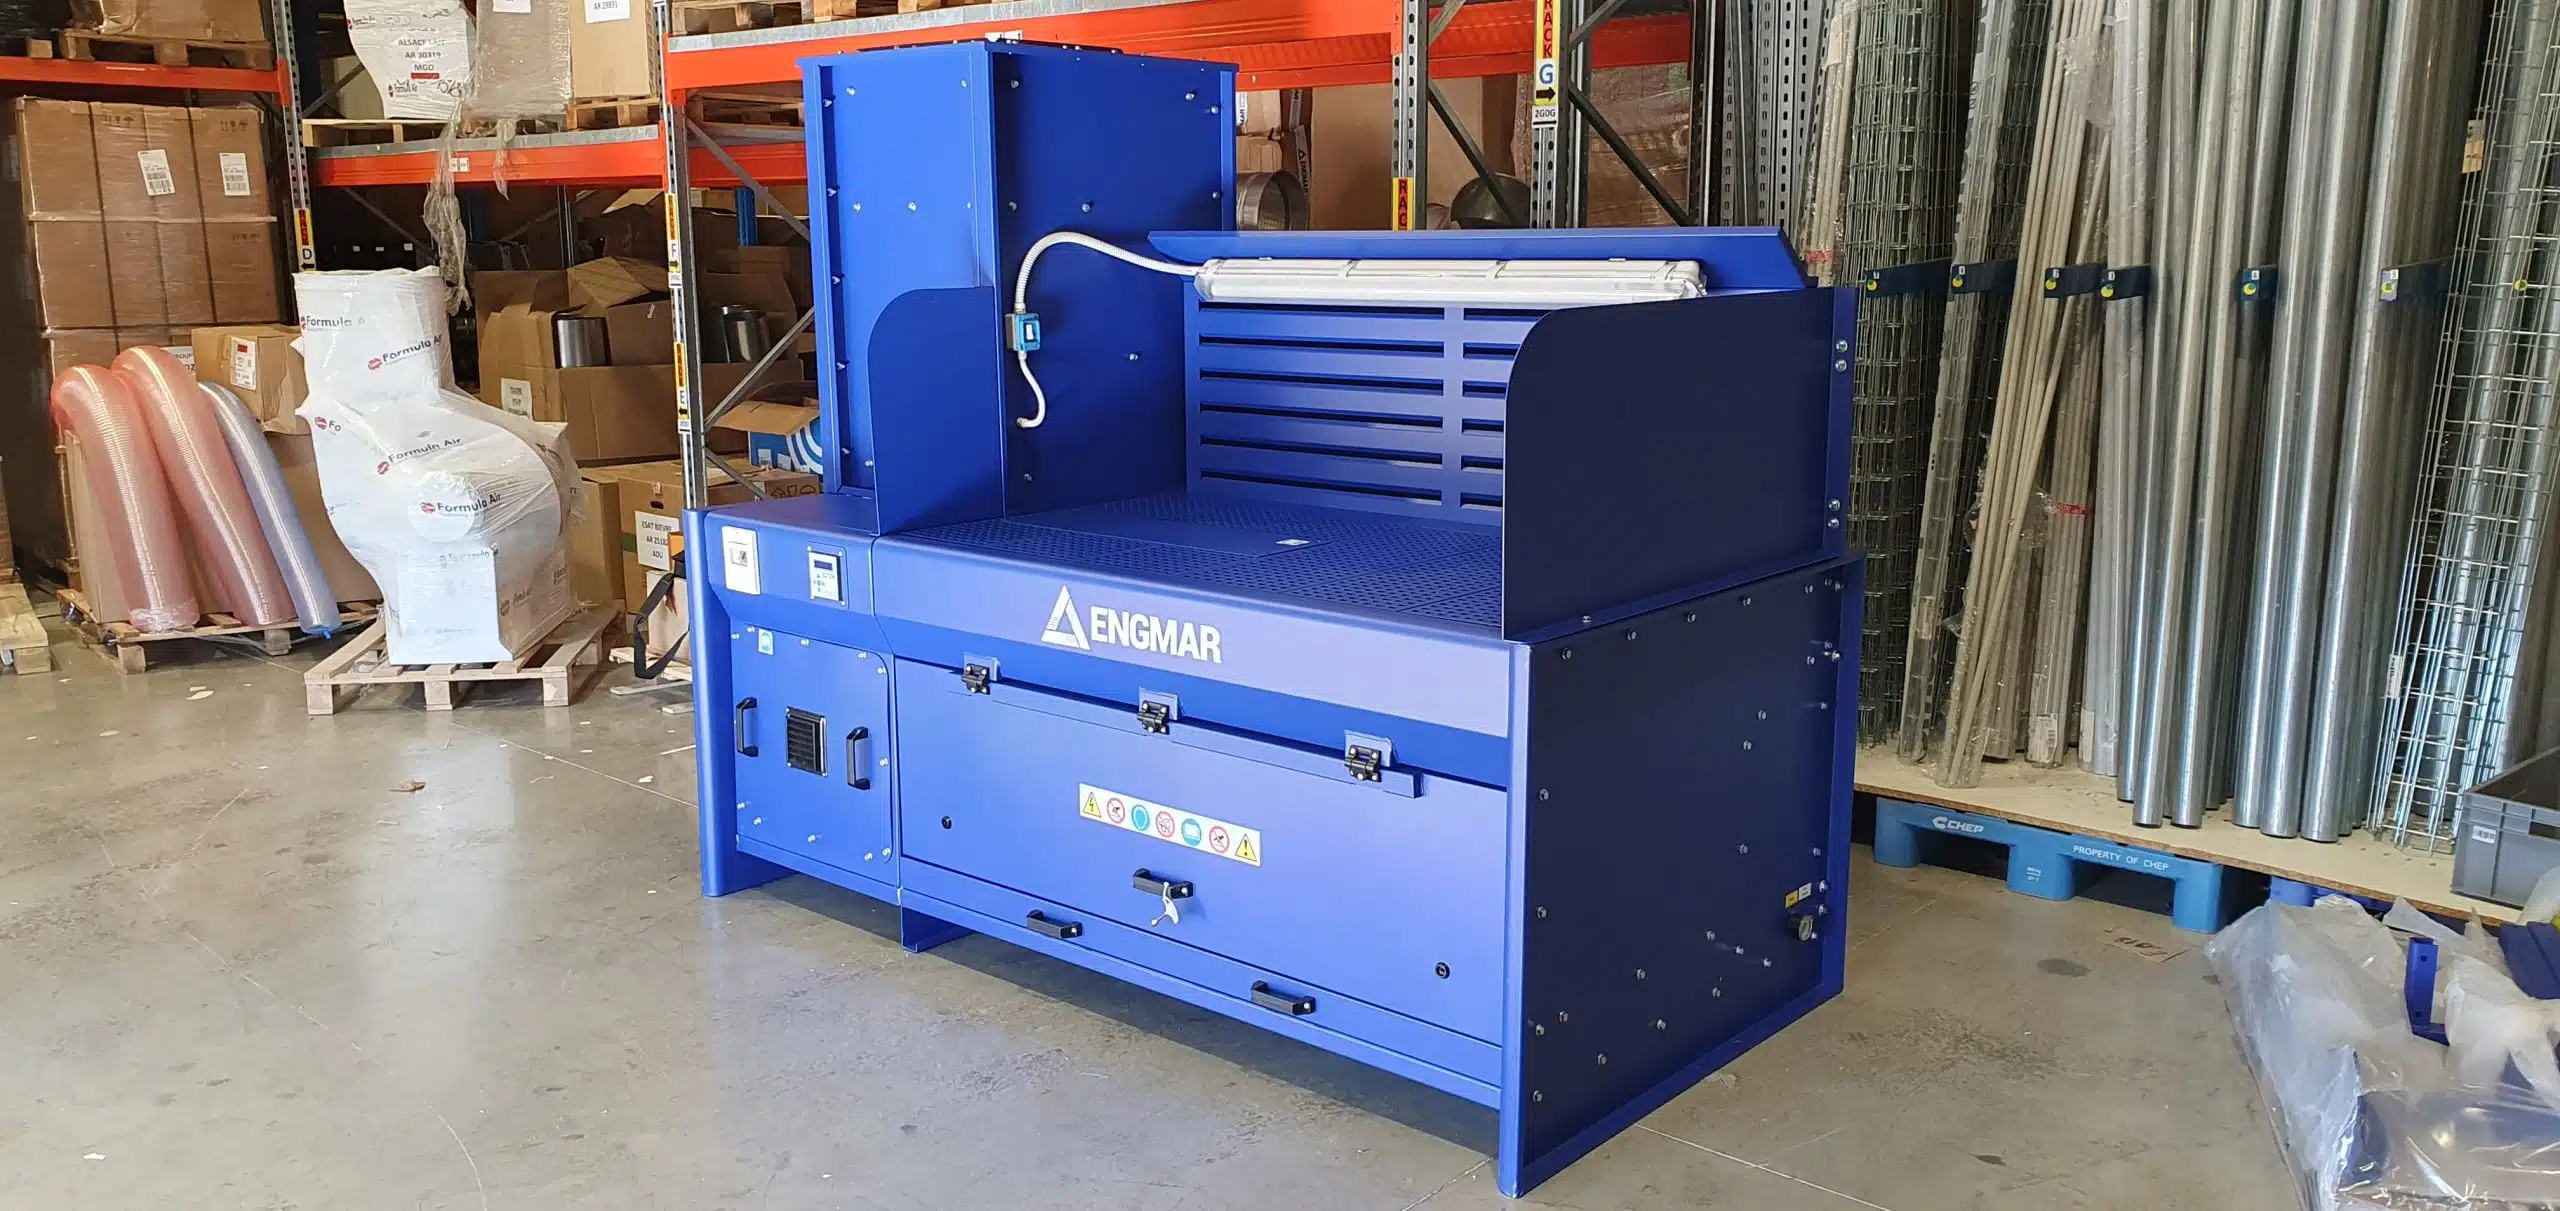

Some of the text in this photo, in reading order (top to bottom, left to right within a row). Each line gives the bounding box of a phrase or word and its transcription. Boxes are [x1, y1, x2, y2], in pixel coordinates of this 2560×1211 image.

[404, 51, 416, 59] AR
[1539, 63, 1554, 84] G
[302, 248, 313, 260] D
[382, 340, 432, 363] Formula
[679, 390, 686, 404] E
[436, 494, 501, 513] Formula Air
[1090, 604, 1222, 664] ENGMAR
[1947, 819, 1985, 833] CHEP
[2072, 844, 2169, 871] PROPERTY OF CHEP
